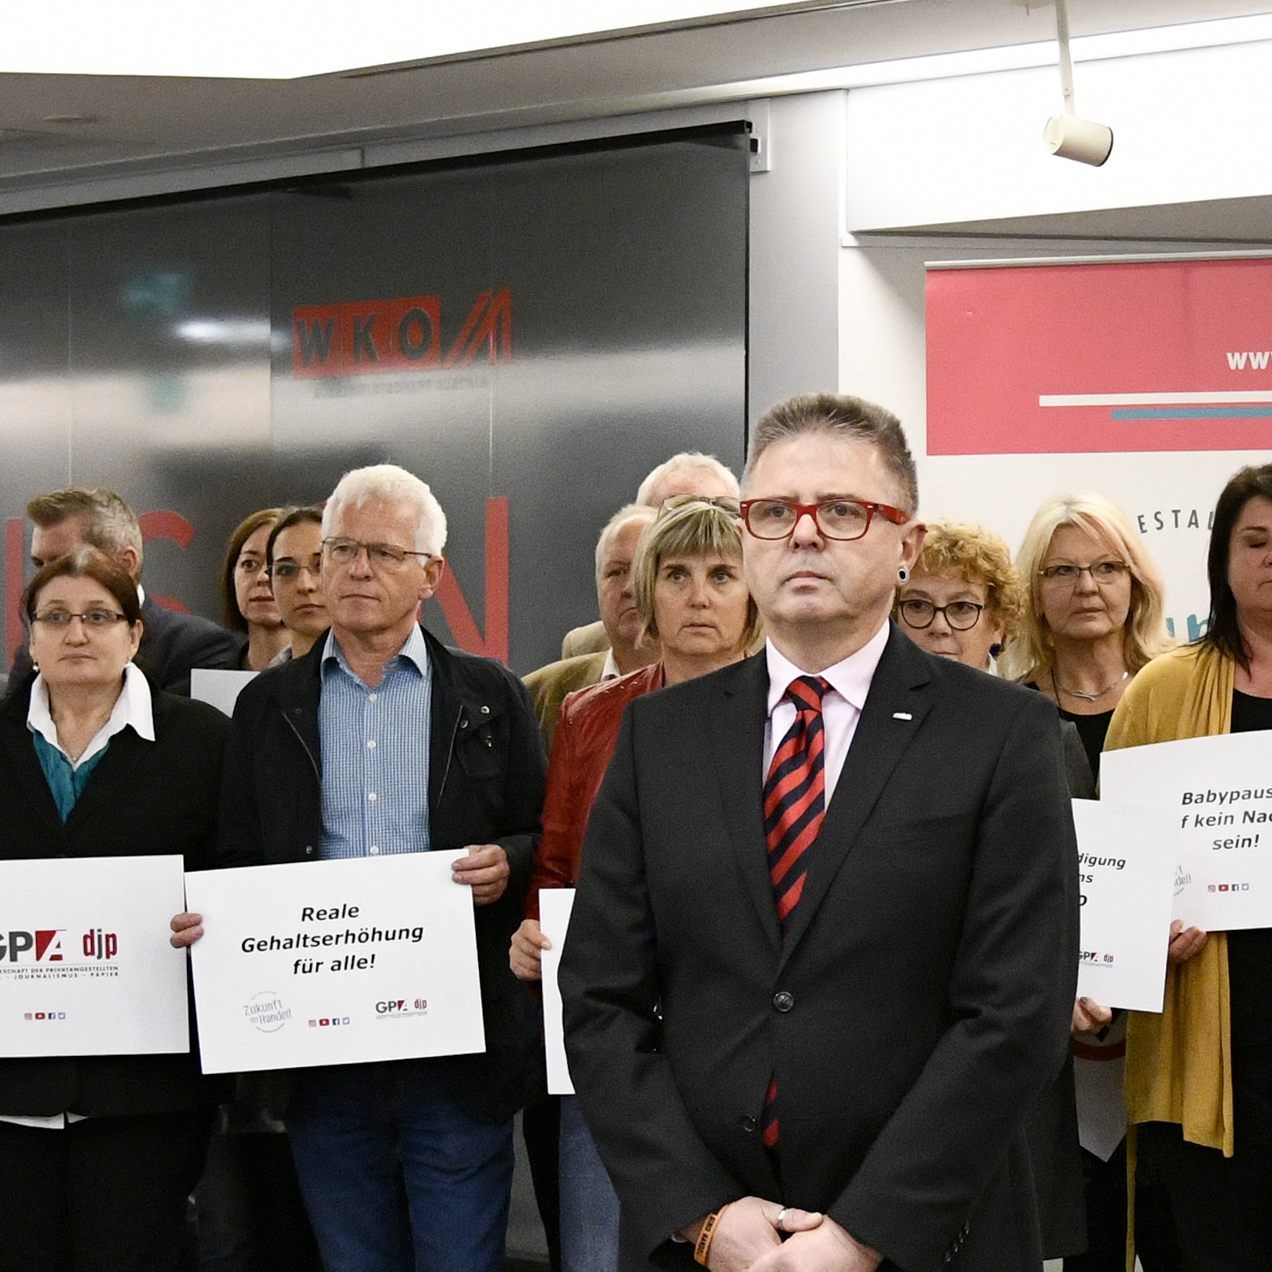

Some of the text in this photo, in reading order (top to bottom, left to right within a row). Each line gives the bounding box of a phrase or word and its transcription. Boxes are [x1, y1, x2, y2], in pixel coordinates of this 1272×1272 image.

[297, 307, 433, 368] WKO
[1194, 812, 1235, 828] kein
[1212, 834, 1260, 850] sein!
[301, 903, 360, 922] Reale
[0, 928, 118, 962] PA djp
[241, 926, 424, 953] Gehaltserhöhung
[293, 953, 376, 974] für alle!
